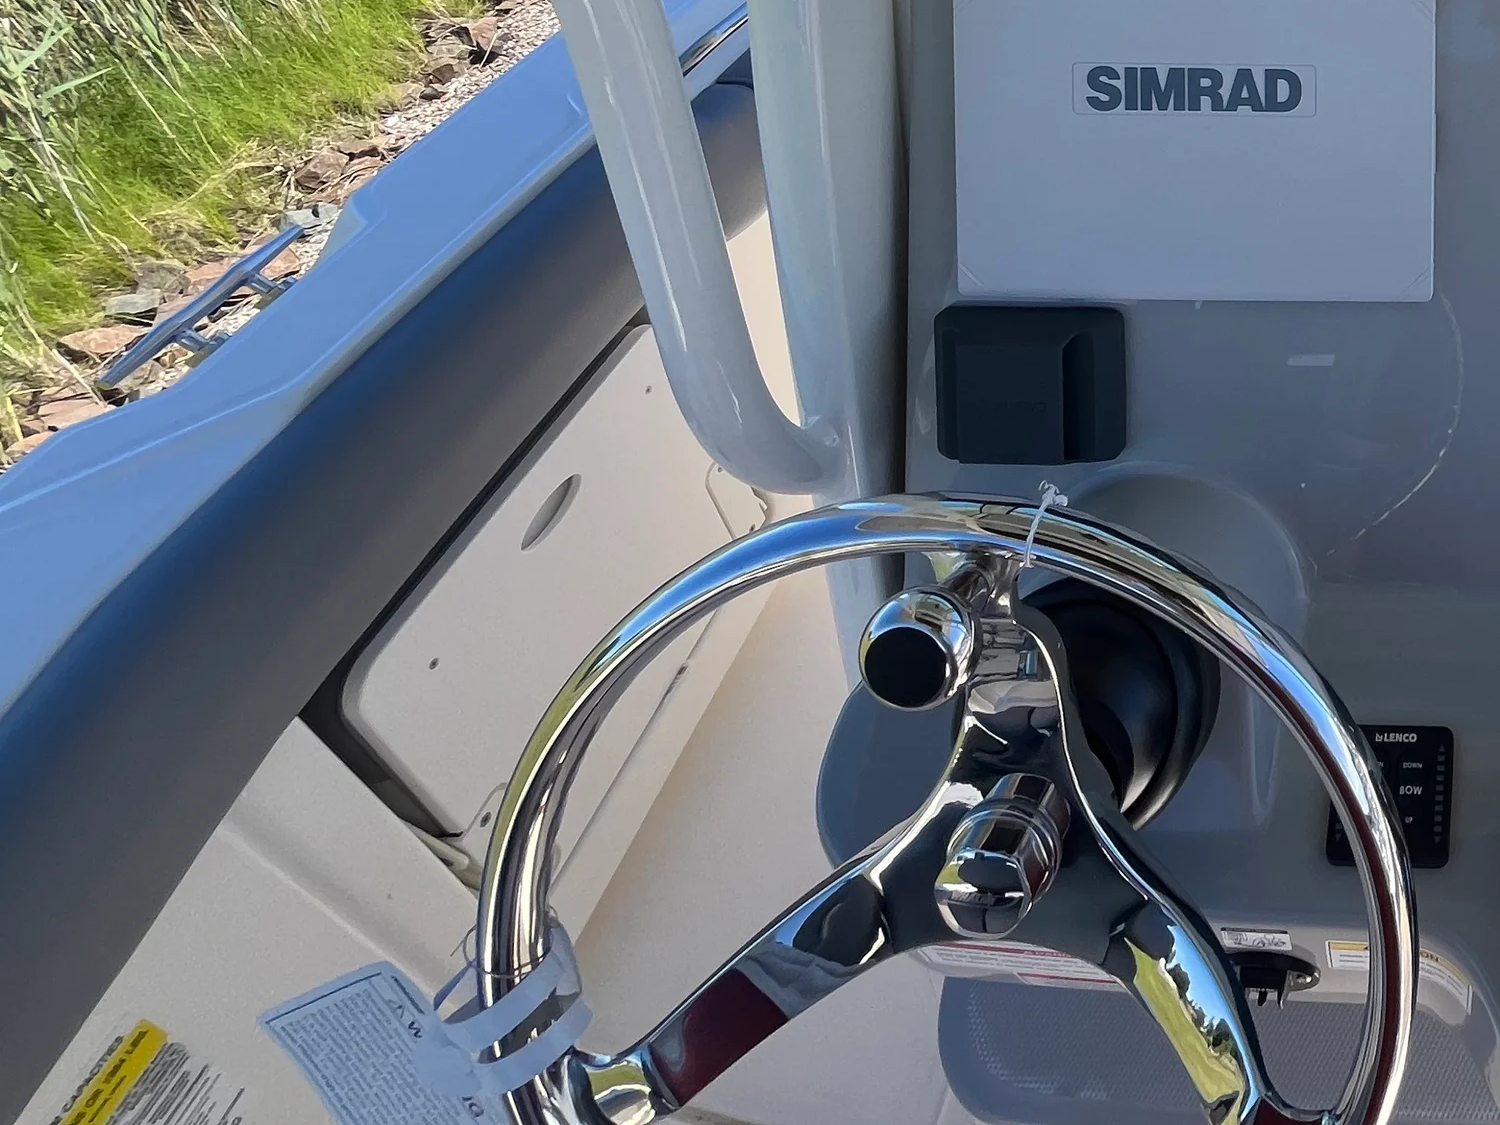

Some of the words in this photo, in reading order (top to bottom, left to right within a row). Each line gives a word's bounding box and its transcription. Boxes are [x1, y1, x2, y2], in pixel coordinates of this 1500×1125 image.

[1086, 65, 1302, 112] SIMRAD
[1383, 732, 1418, 743] LENCO
[1402, 761, 1423, 769] DOWN
[1399, 785, 1423, 795] BOW
[1405, 816, 1414, 824] UP
